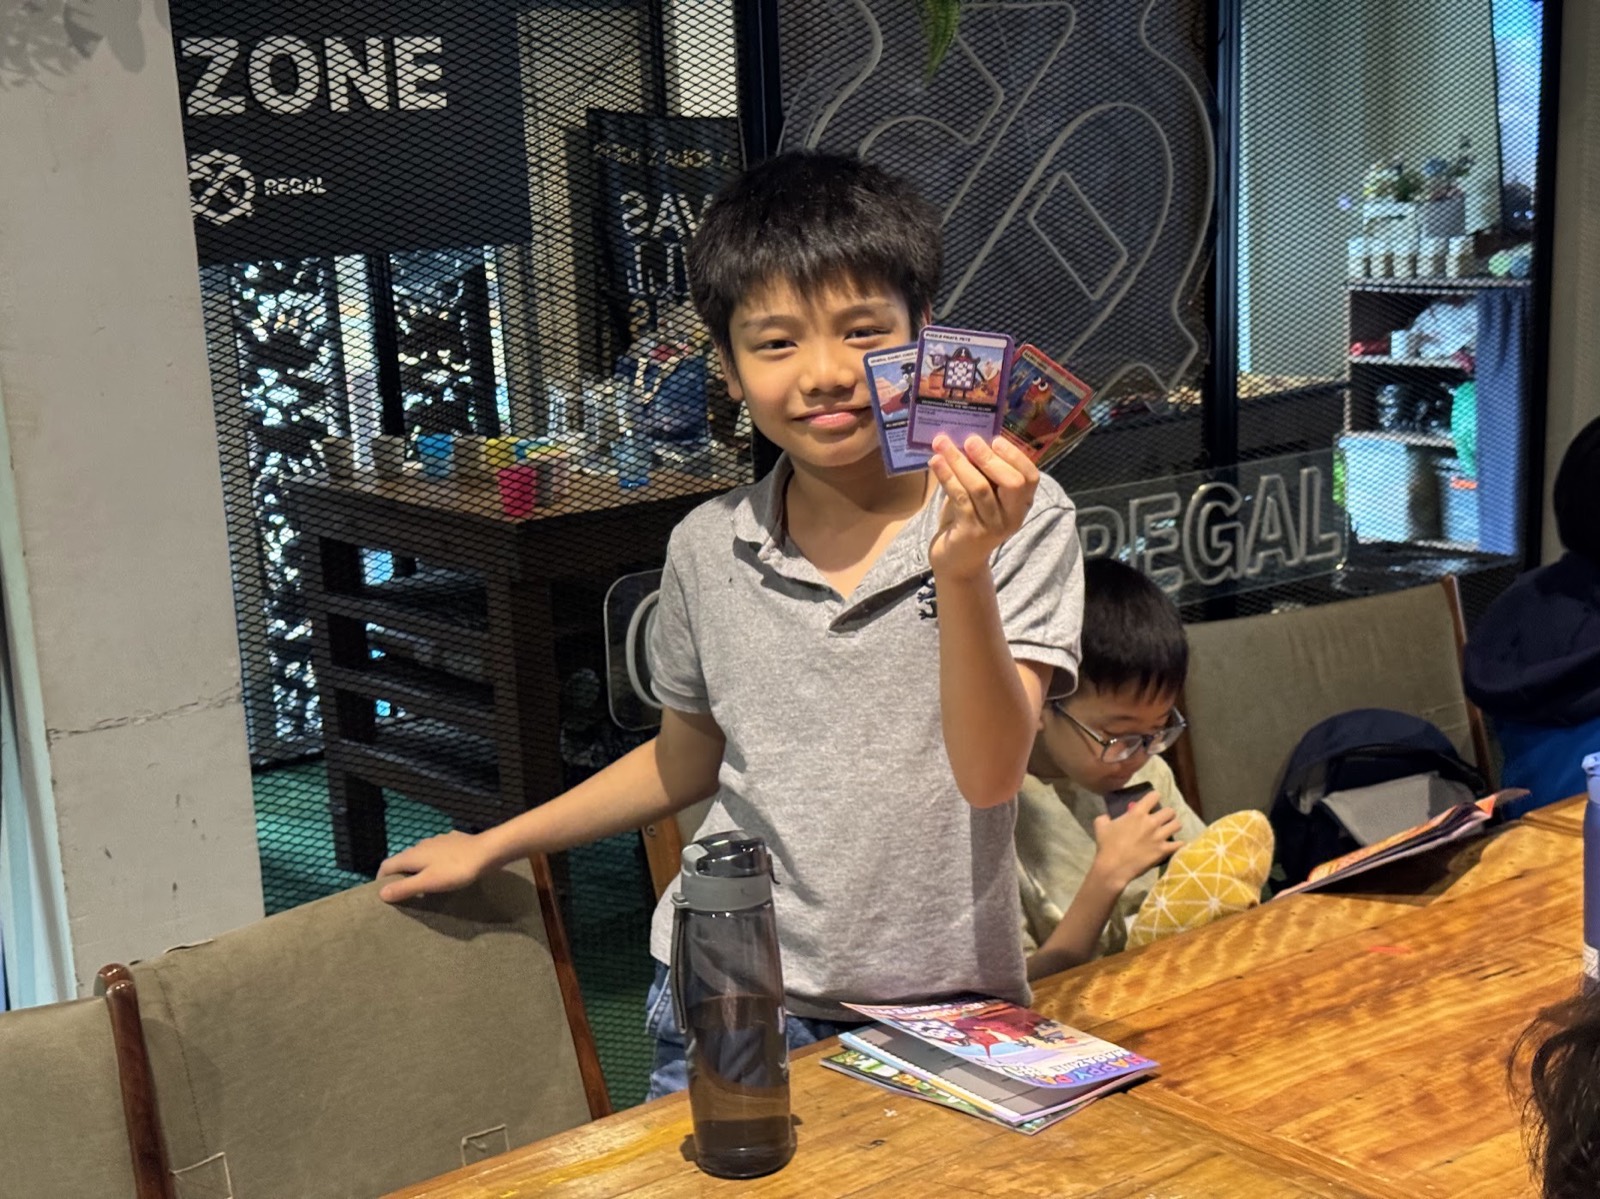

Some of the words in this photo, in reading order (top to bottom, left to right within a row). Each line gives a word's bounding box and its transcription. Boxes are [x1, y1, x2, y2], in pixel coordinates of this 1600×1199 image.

[181, 35, 447, 115] ZONE
[263, 177, 327, 196] REGAL
[1072, 1053, 1149, 1081] HAPPY
